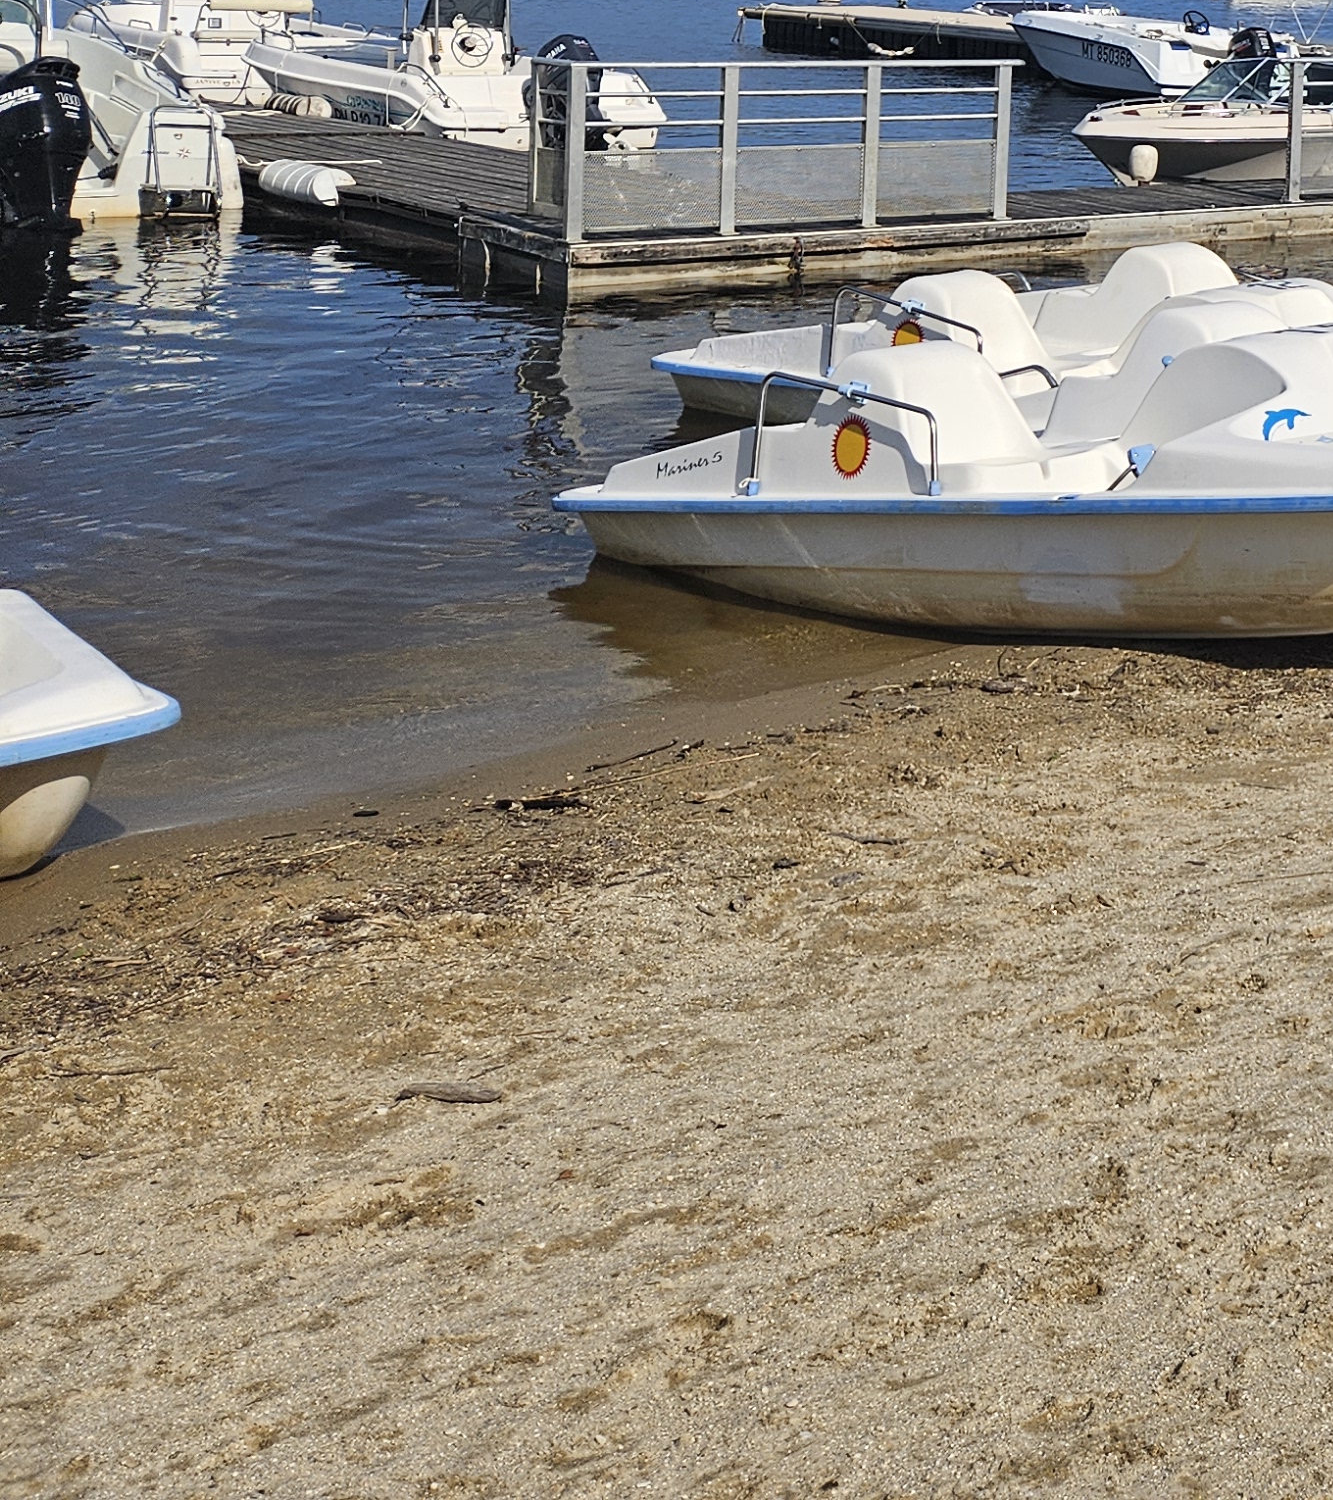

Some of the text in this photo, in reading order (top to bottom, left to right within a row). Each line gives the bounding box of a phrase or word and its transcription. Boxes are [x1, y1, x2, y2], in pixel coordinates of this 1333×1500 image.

[1082, 41, 1095, 60] MT
[0, 85, 34, 103] ZUKI
[656, 458, 709, 480] Mariner
